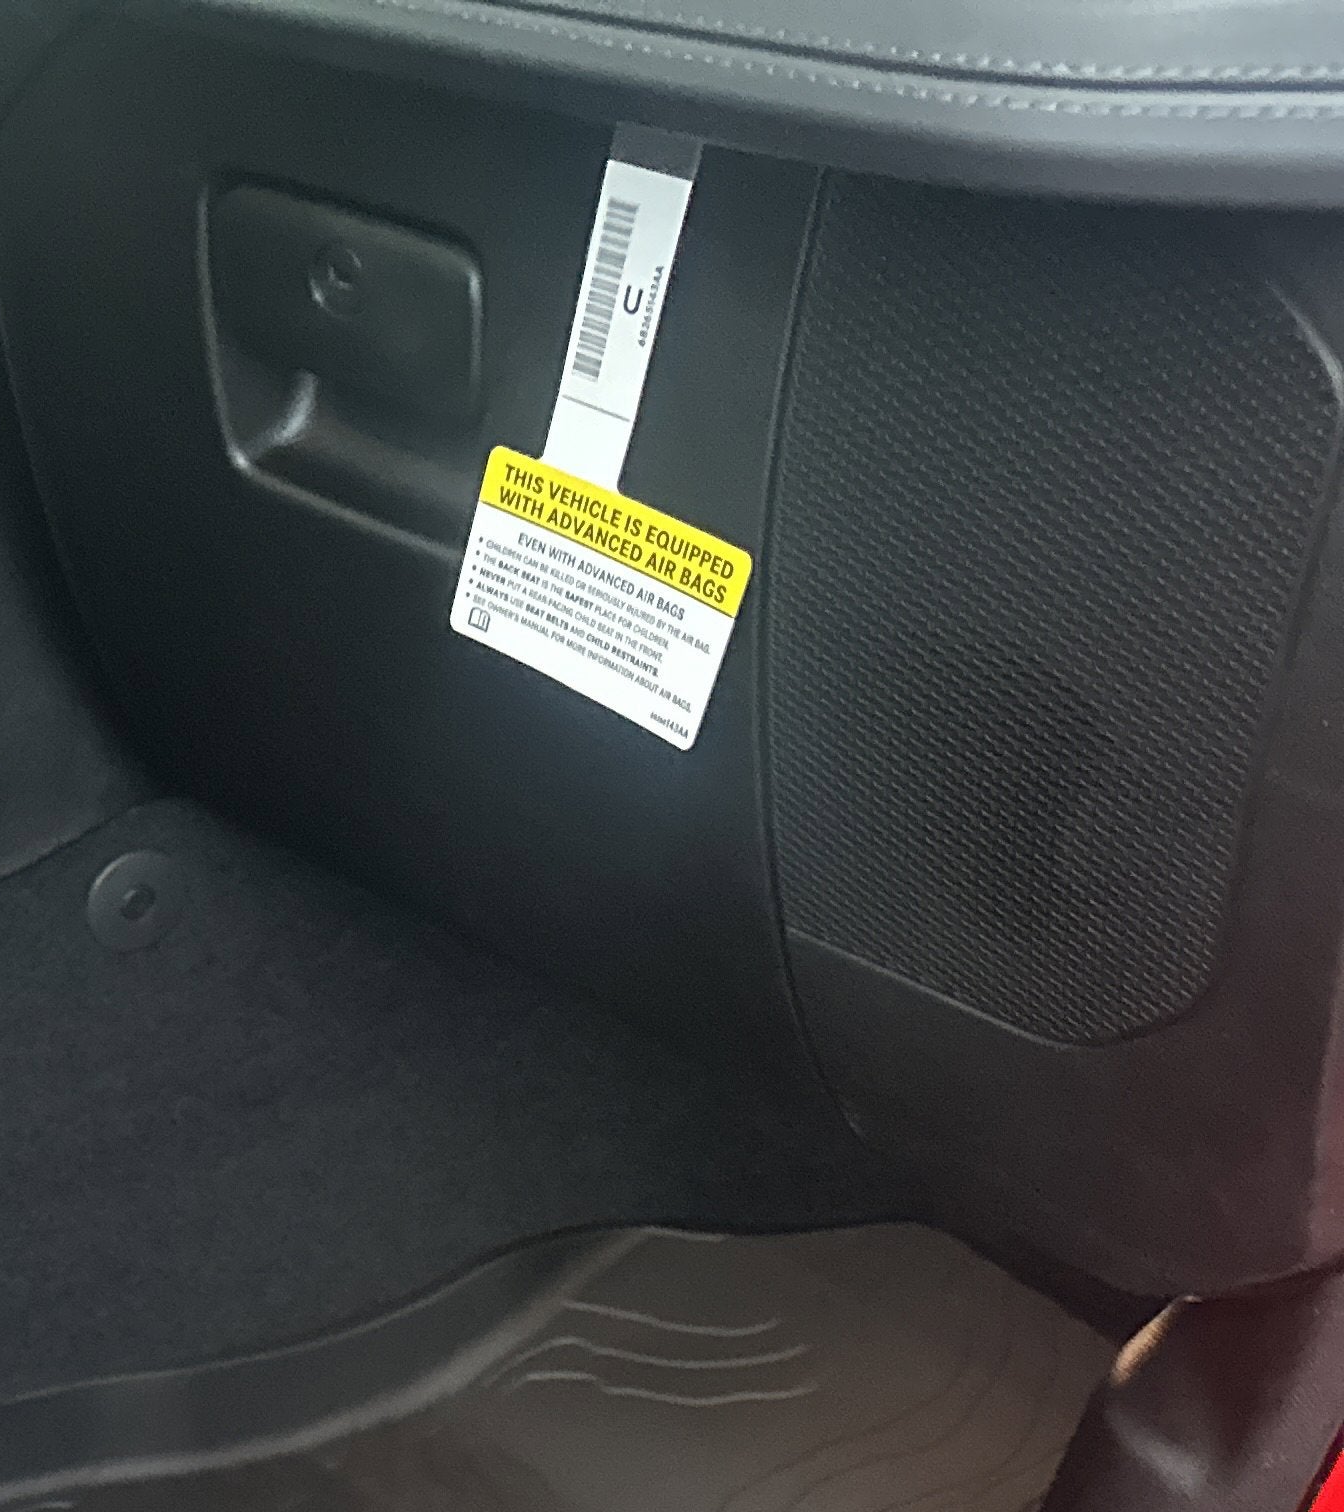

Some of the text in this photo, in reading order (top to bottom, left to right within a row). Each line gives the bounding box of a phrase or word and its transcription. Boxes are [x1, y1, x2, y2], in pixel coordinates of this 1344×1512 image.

[623, 284, 643, 315] U
[498, 485, 728, 603] WITH ADVANCED AIR BAGS
[503, 463, 735, 580] THIS VEHICLE IS EQUIPPED
[477, 579, 508, 602] ALWAYS
[525, 603, 544, 618] SEAT
[546, 612, 568, 630] BELTS
[586, 633, 610, 651] CHILD
[480, 567, 505, 585] NEVER
[507, 579, 520, 591] PUT
[522, 586, 527, 594] A
[574, 611, 596, 628] CHILD
[597, 622, 614, 636] SEAT
[614, 631, 623, 641] IN
[624, 636, 638, 649] THE
[487, 538, 521, 562] CHILDREN
[523, 554, 538, 568] CAN
[540, 562, 548, 572] BE
[550, 567, 574, 585] KILLED
[575, 579, 586, 590] OR
[656, 619, 666, 630] BY
[666, 624, 680, 638] THE
[681, 632, 694, 645] AIR
[499, 559, 519, 575] BACK
[521, 570, 539, 584] SEAT
[550, 583, 563, 595] THE
[565, 590, 593, 610] SAFEST
[594, 605, 616, 621] PLACE
[618, 616, 632, 629] FOR
[518, 532, 685, 620] EVEN WITH ADVANCED AIR BAGS
[521, 615, 549, 636] MANUAL
[551, 631, 565, 644] FOR
[566, 639, 585, 654] MORE
[586, 649, 634, 680] INFORMATION
[634, 675, 658, 693] ABOUT
[659, 688, 671, 700] AIR
